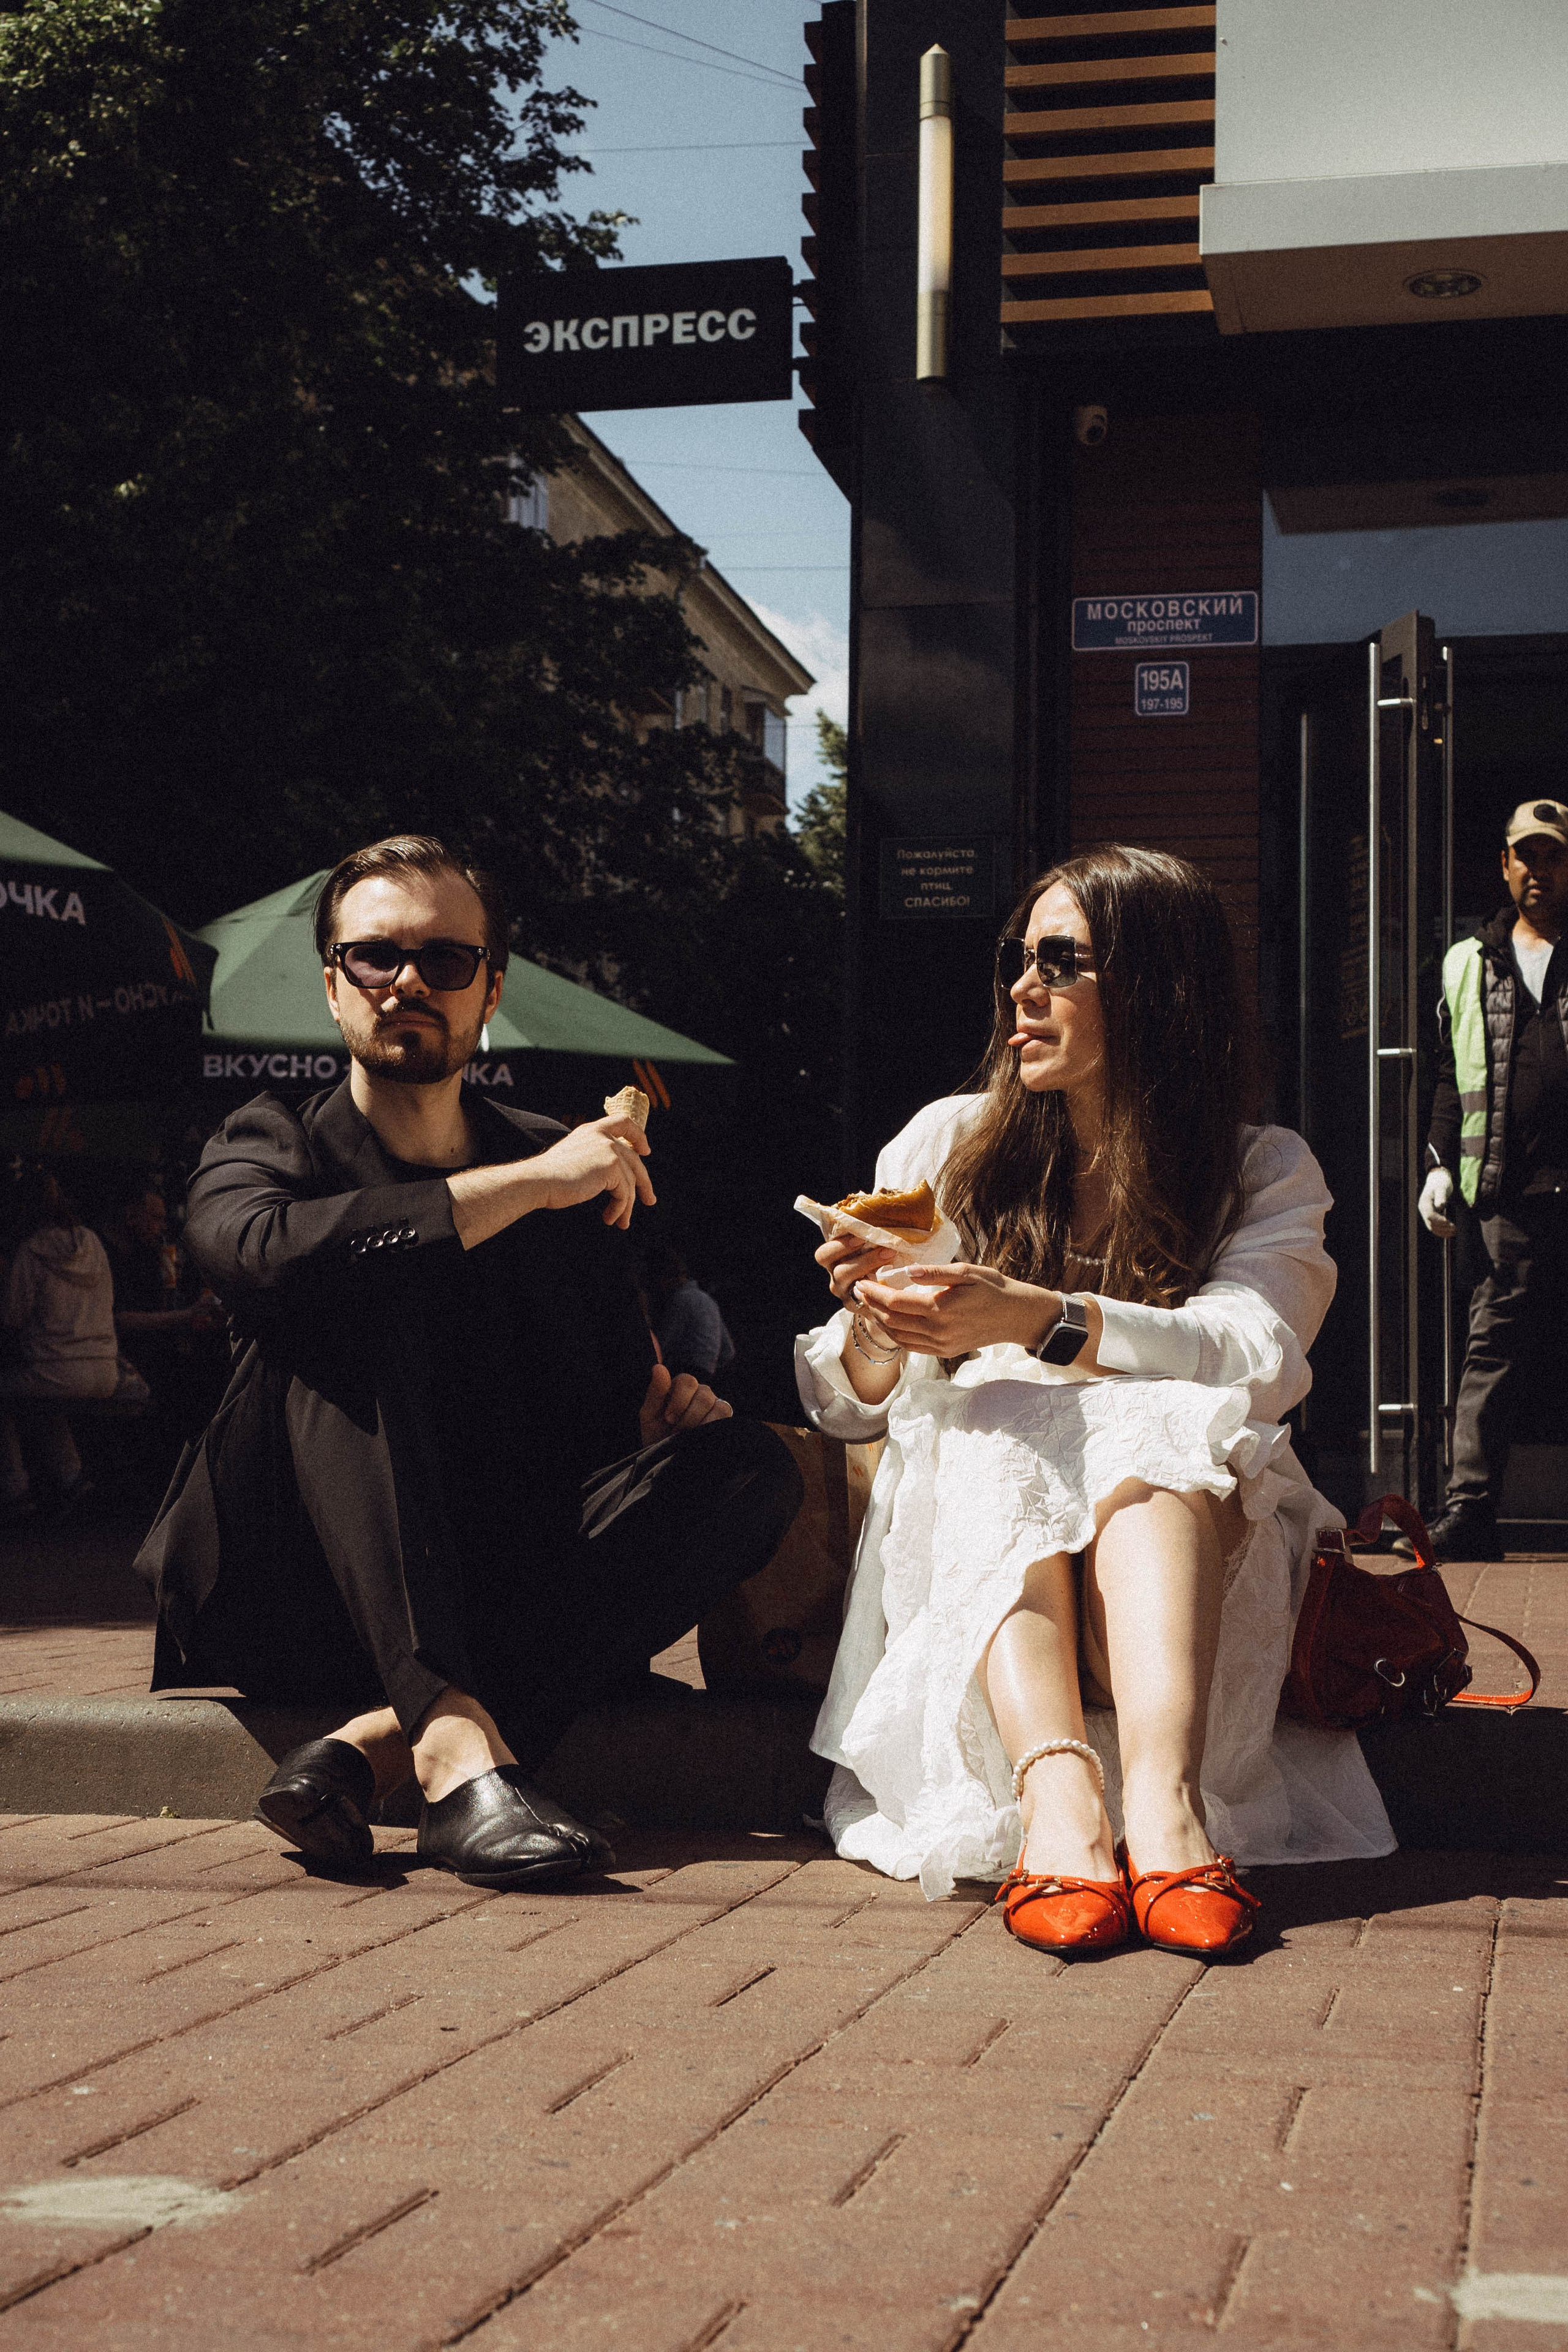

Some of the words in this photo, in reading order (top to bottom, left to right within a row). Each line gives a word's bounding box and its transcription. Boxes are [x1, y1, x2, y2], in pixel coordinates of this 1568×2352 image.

[523, 307, 756, 353] ЭКСПРЕСС
[1087, 594, 1243, 620] МОСКОВСКИЙ
[1127, 618, 1201, 635] проспект
[901, 867, 916, 876] не
[920, 865, 974, 877] кормите
[903, 895, 970, 908] СПАСИБО!
[203, 1054, 337, 1079] ВКУСНО
